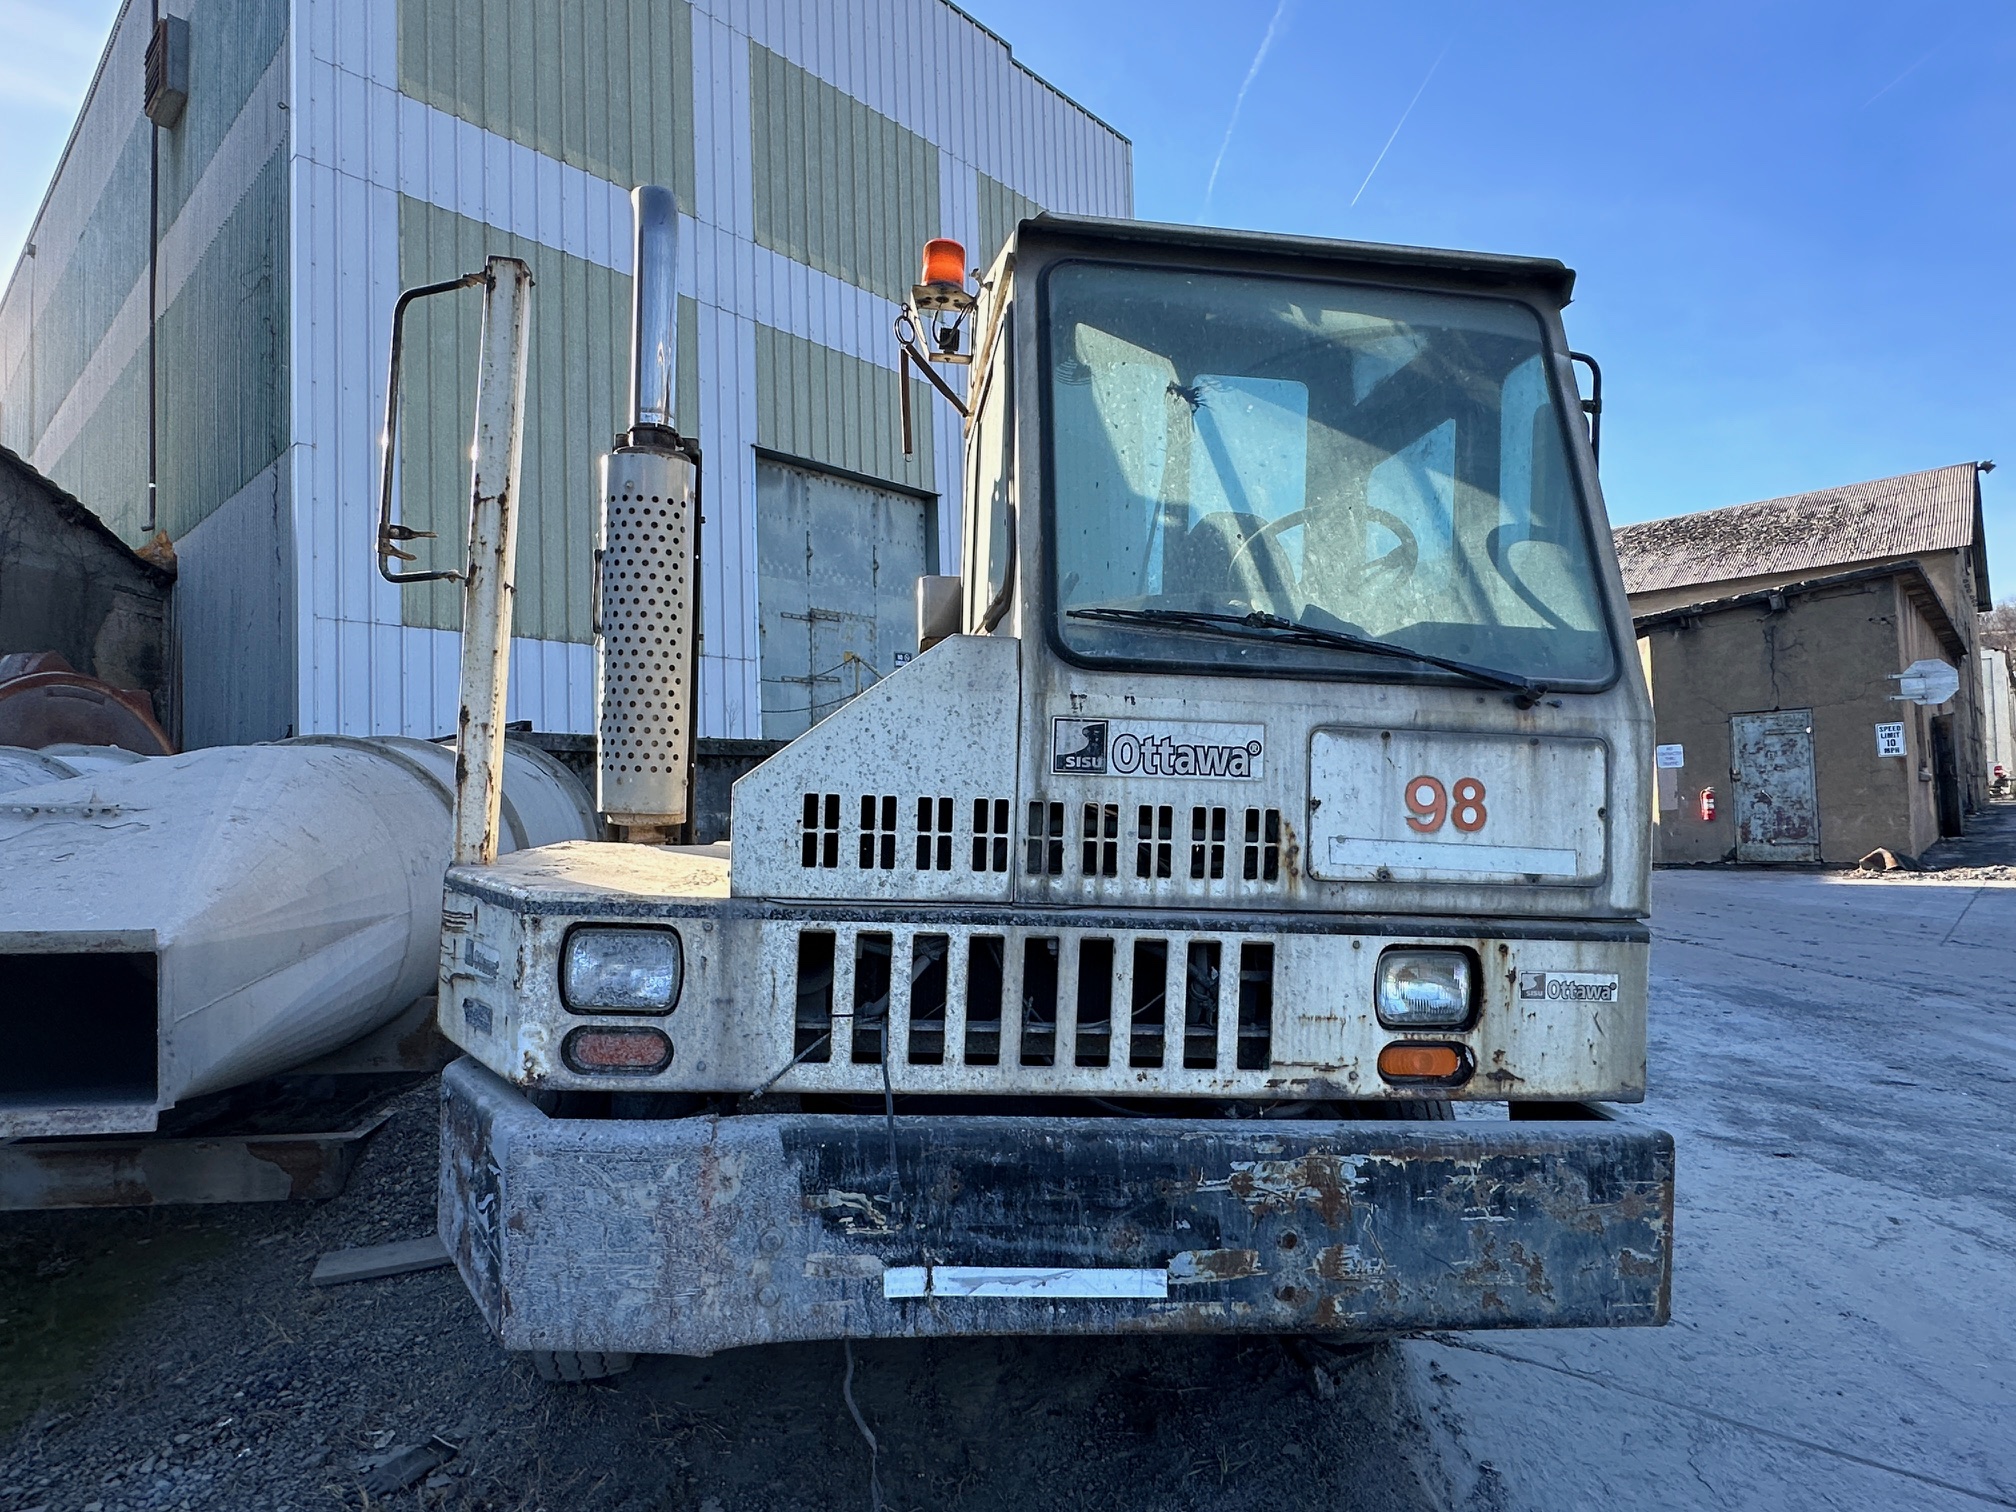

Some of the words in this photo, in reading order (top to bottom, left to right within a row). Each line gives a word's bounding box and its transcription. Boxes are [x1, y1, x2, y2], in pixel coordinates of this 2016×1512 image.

[1886, 738, 1896, 747] 10
[1064, 756, 1104, 769] SISU
[1403, 775, 1487, 834] 98
